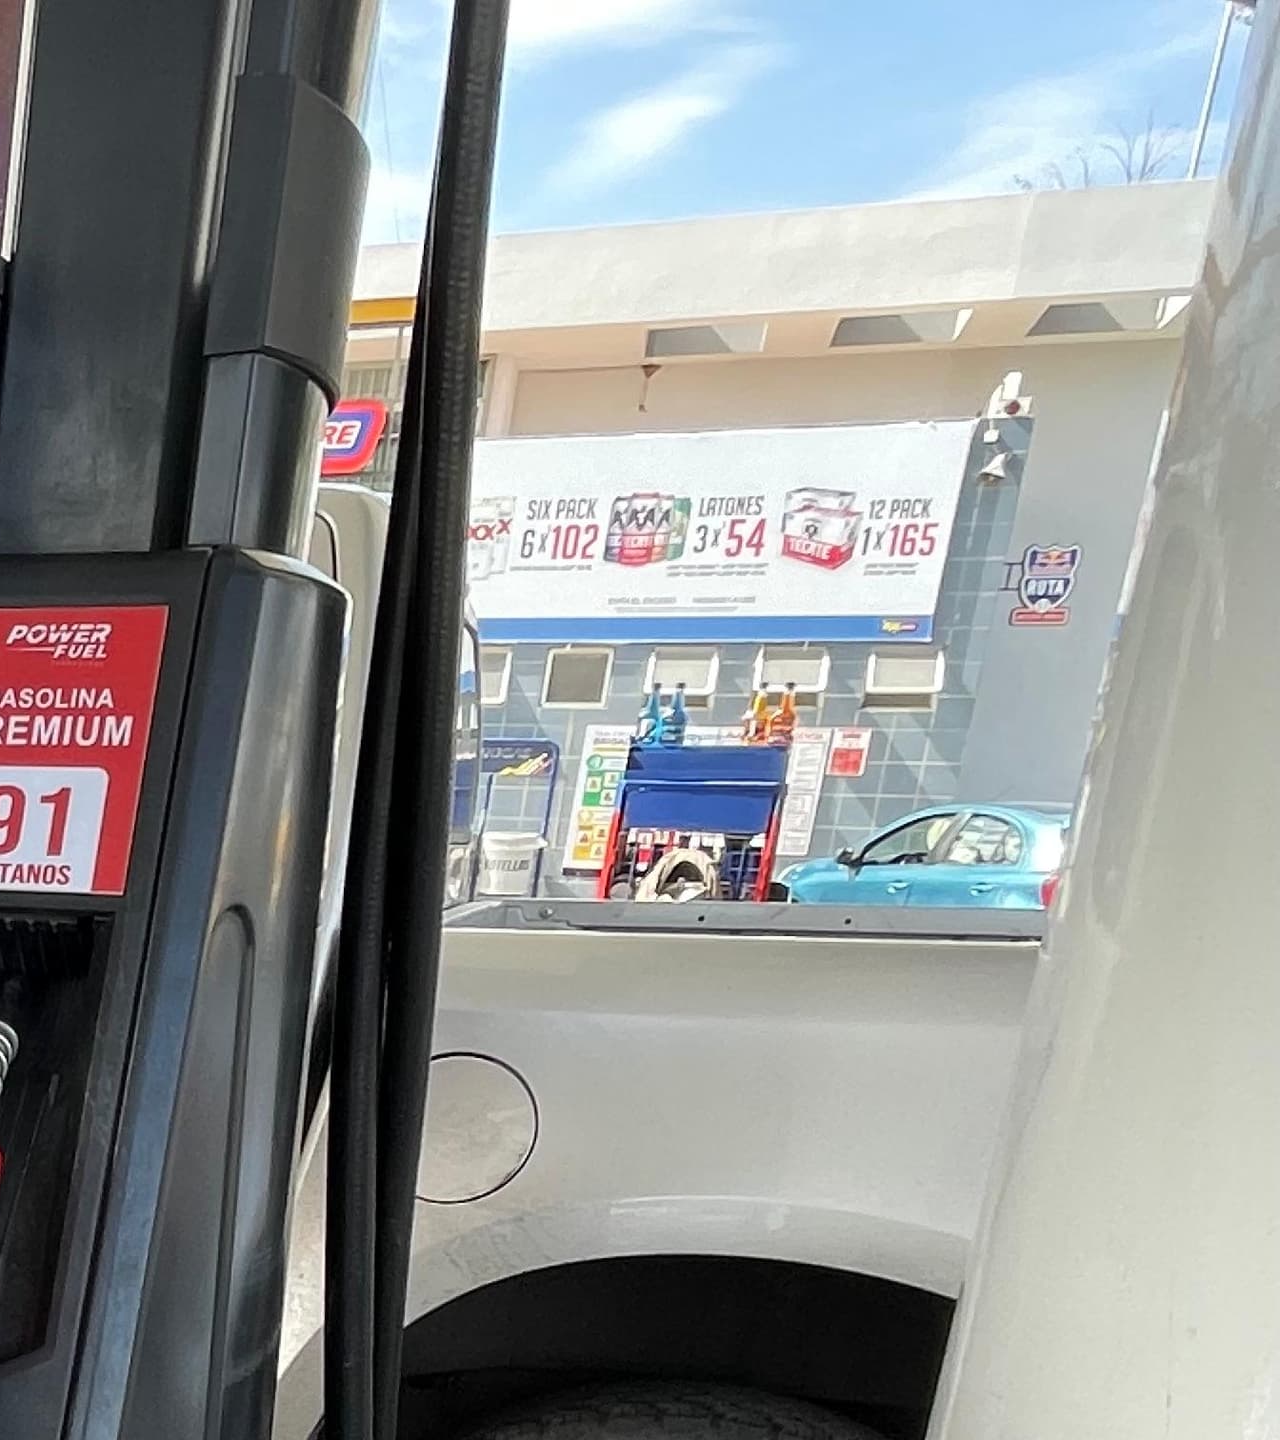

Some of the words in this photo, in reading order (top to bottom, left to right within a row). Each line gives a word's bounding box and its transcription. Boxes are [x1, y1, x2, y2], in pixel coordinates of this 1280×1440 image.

[324, 424, 356, 445] RE
[526, 499, 550, 520] SIX
[555, 498, 598, 520] PACK
[698, 496, 765, 517] LATONES
[869, 500, 886, 519] 12
[890, 498, 933, 519] PACK
[6, 623, 113, 644] POWER
[52, 644, 108, 659] FUEL
